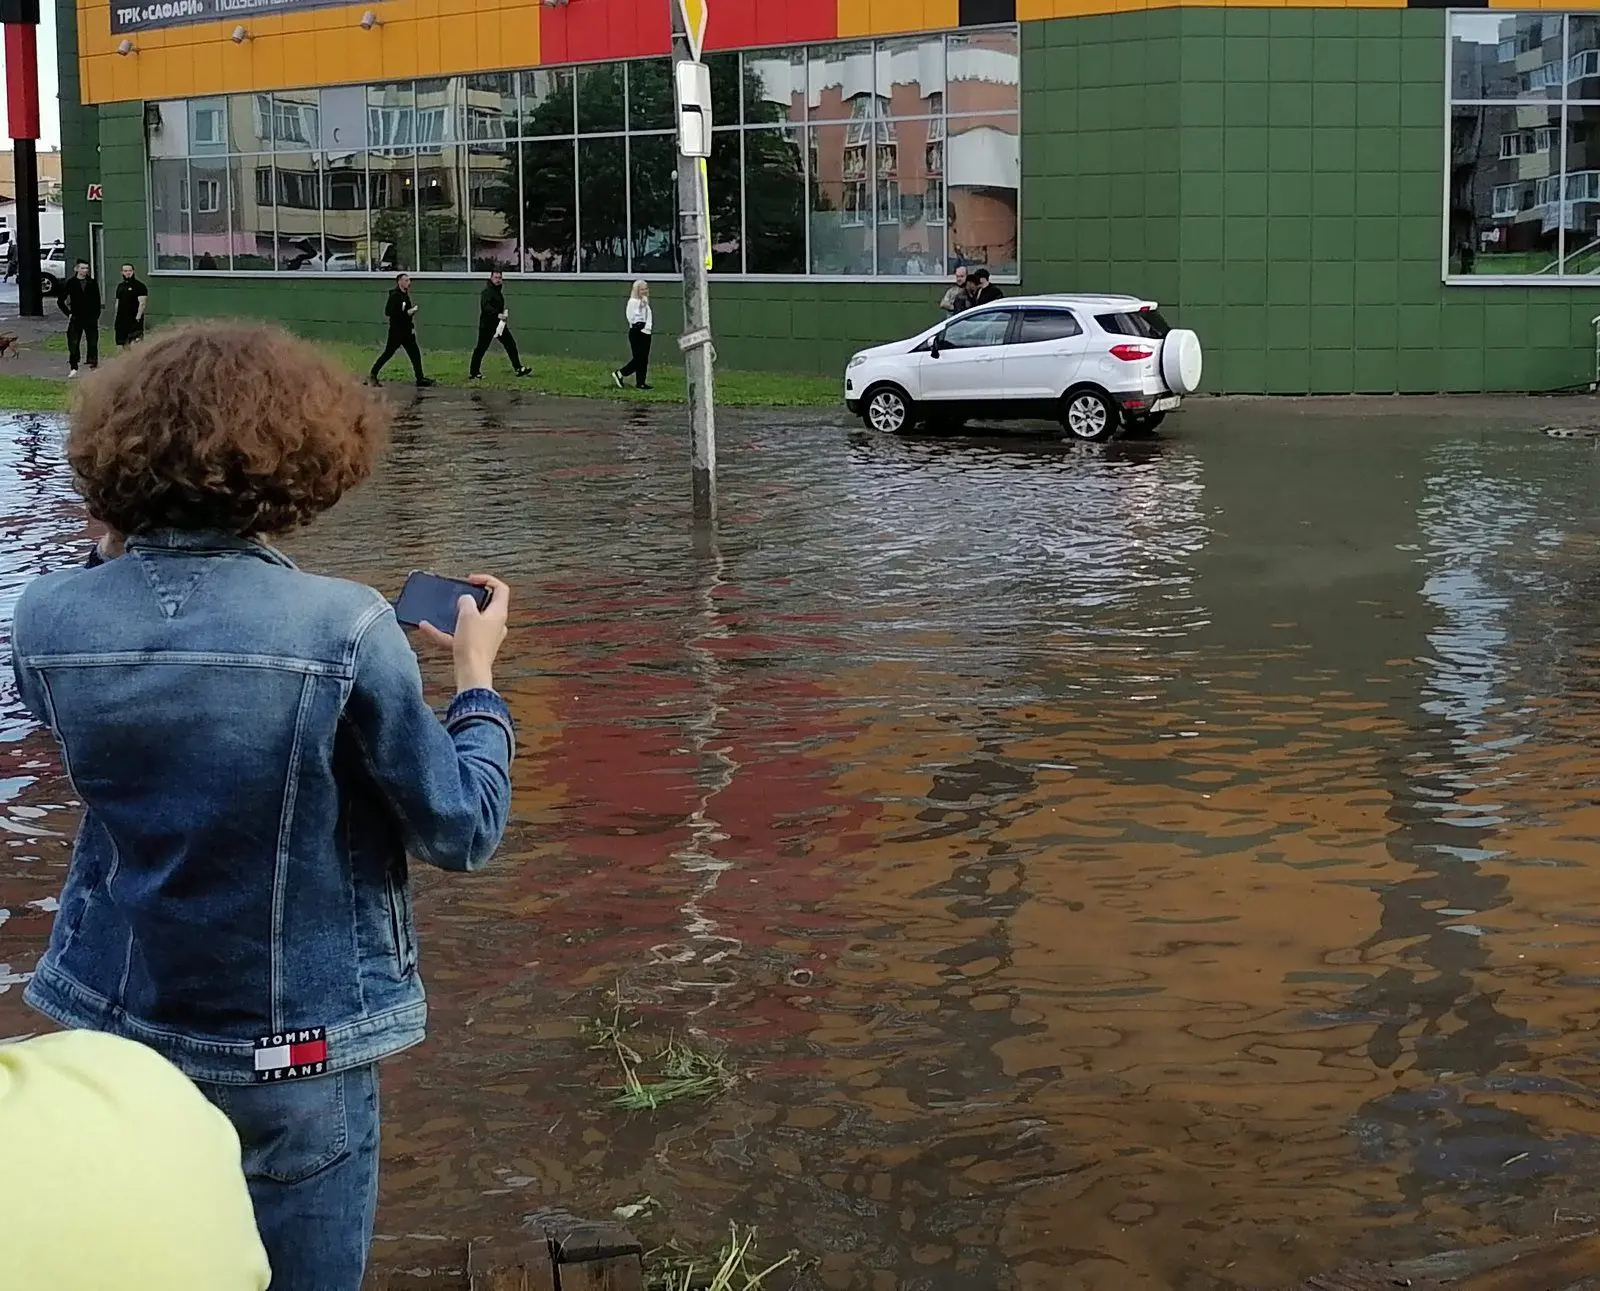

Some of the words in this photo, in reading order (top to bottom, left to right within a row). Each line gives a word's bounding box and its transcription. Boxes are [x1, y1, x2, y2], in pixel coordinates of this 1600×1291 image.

[117, 7, 141, 24] ТРК
[261, 1029, 321, 1046] TOMMY
[262, 1063, 323, 1080] JEANS
